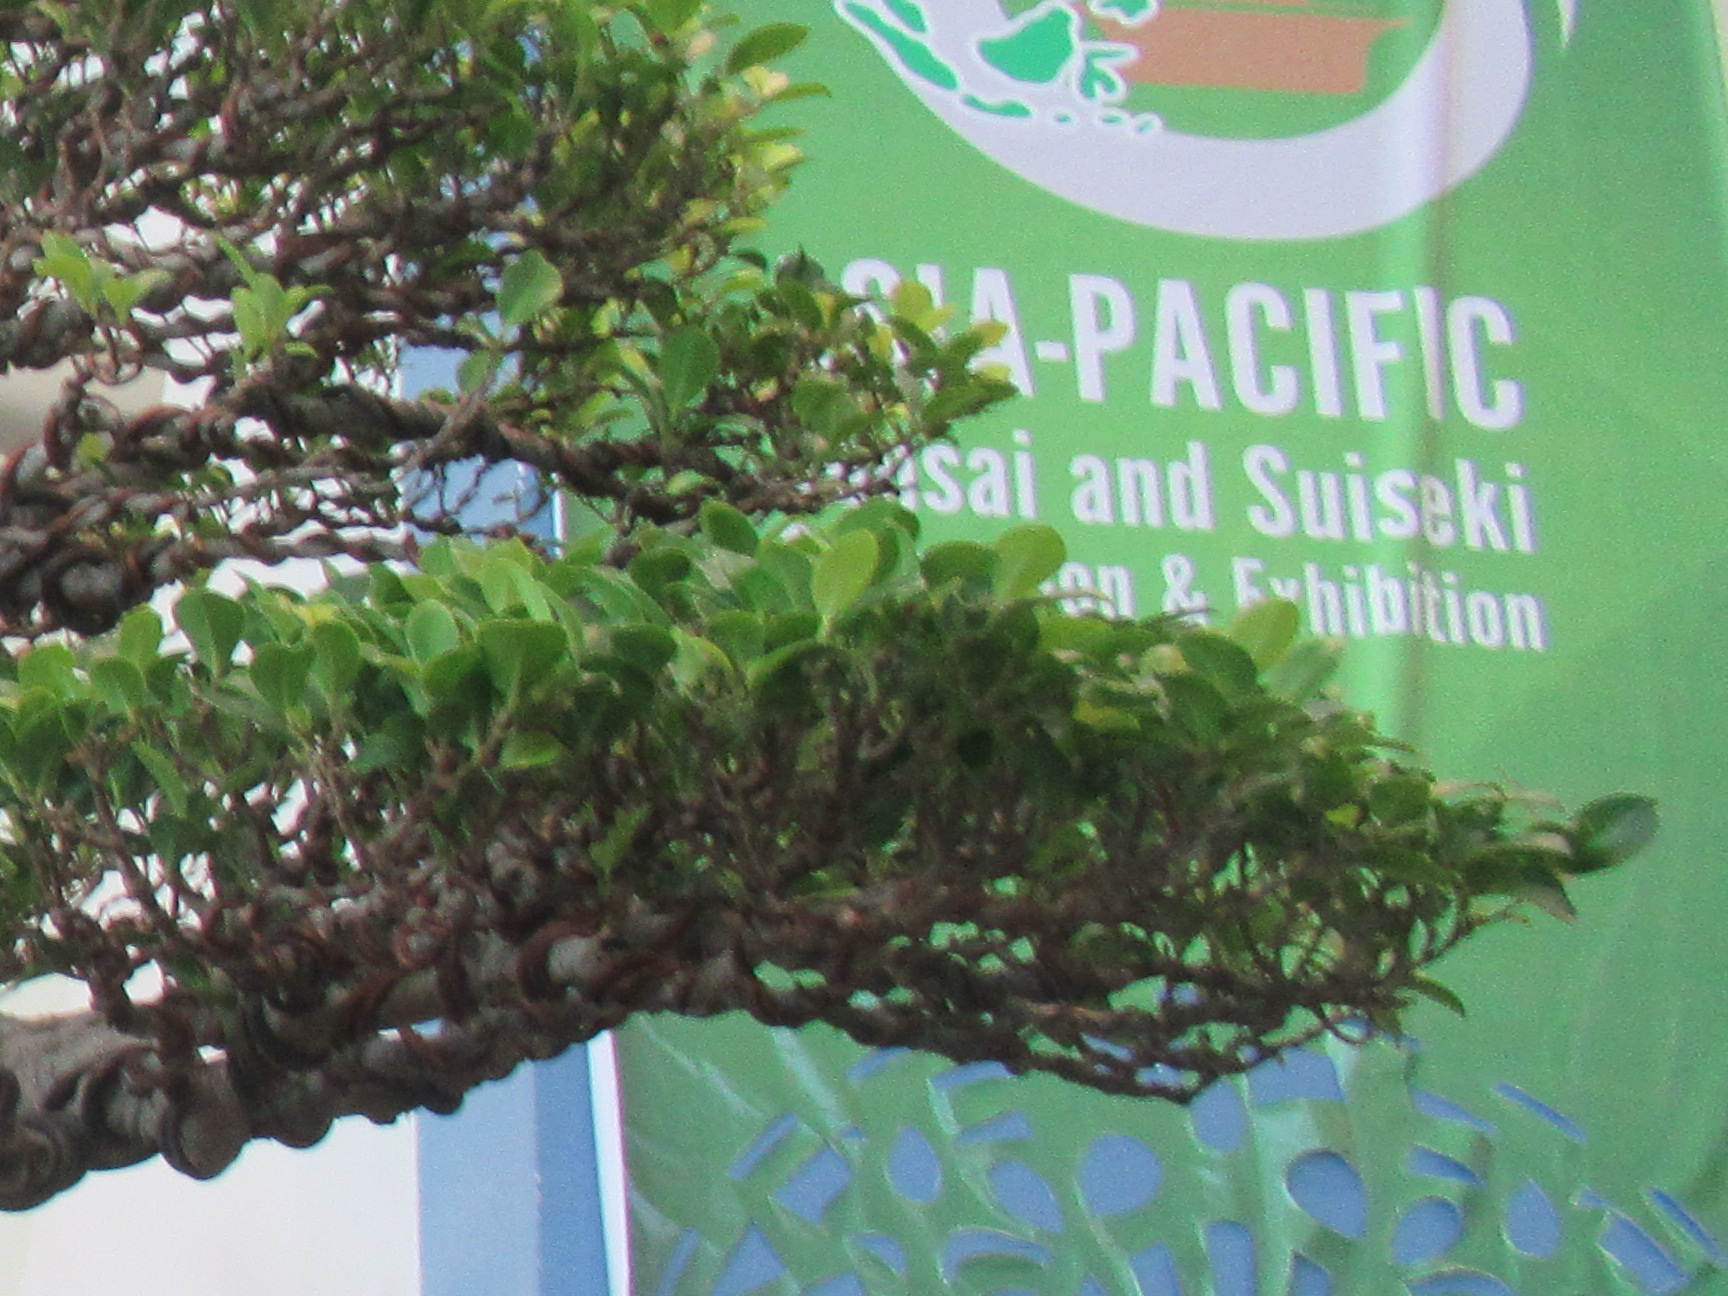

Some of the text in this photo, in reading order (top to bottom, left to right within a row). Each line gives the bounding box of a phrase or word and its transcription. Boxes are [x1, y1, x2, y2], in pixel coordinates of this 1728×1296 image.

[1069, 441, 1215, 531] and
[1243, 443, 1538, 554] Suiseki
[1162, 554, 1209, 626] &
